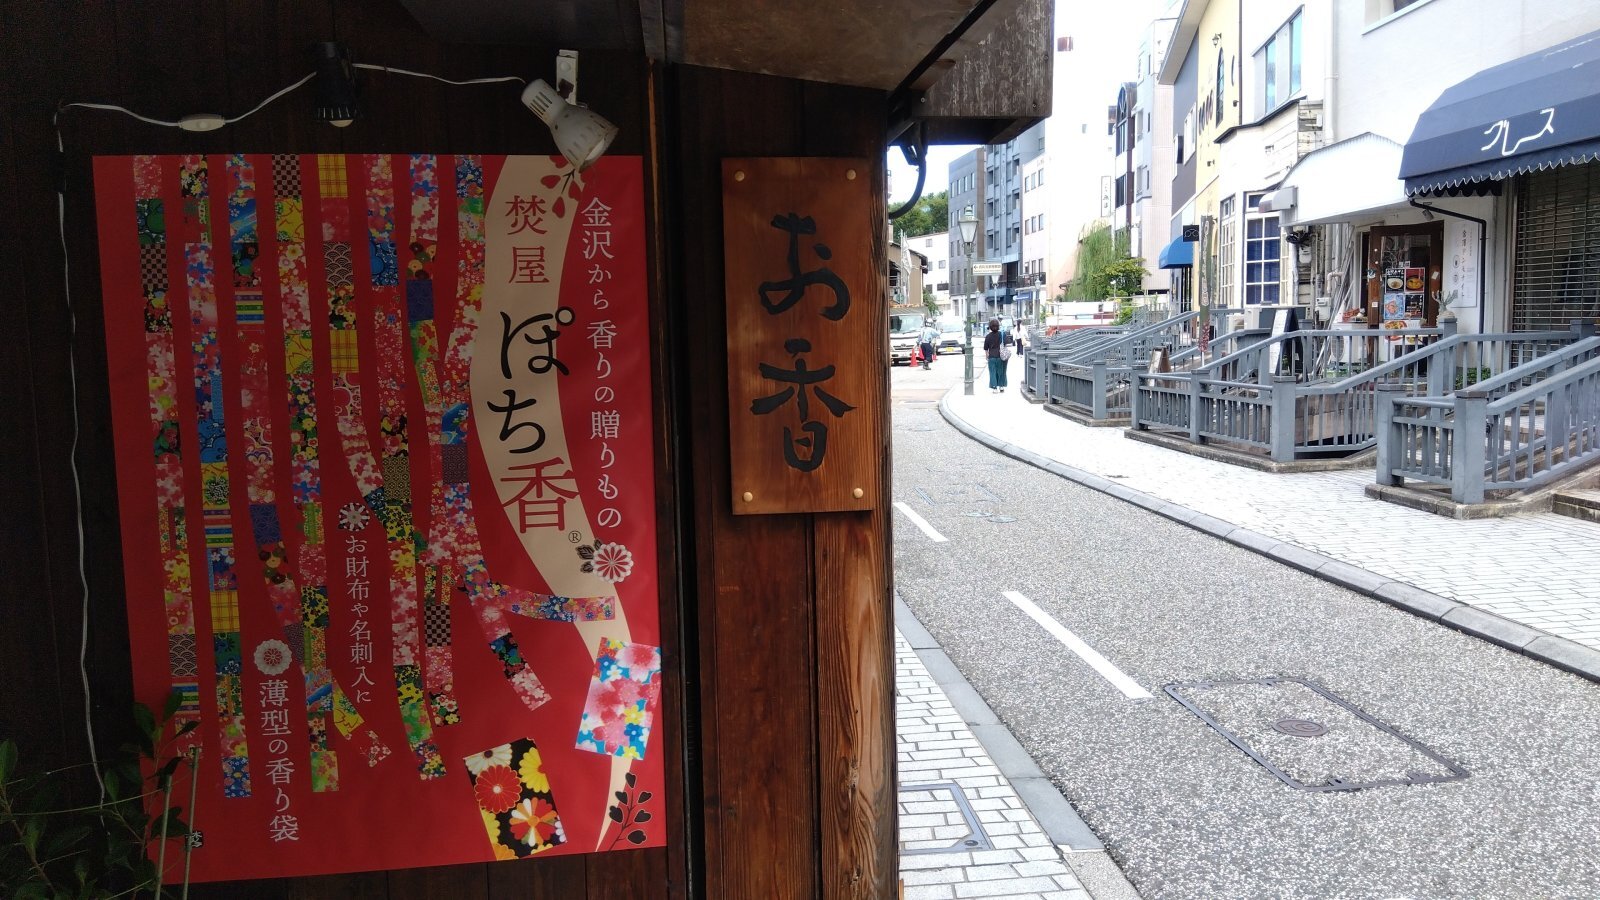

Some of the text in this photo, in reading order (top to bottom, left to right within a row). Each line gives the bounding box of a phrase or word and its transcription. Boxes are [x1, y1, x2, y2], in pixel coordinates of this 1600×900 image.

[1480, 107, 1555, 157] グレース
[504, 194, 550, 286] 焚屋
[581, 196, 622, 529] 金沢から香りの贈りもの
[750, 212, 856, 473] お香
[345, 533, 376, 705] お財布や名刺入に
[258, 679, 300, 843] 薄型の香り袋
